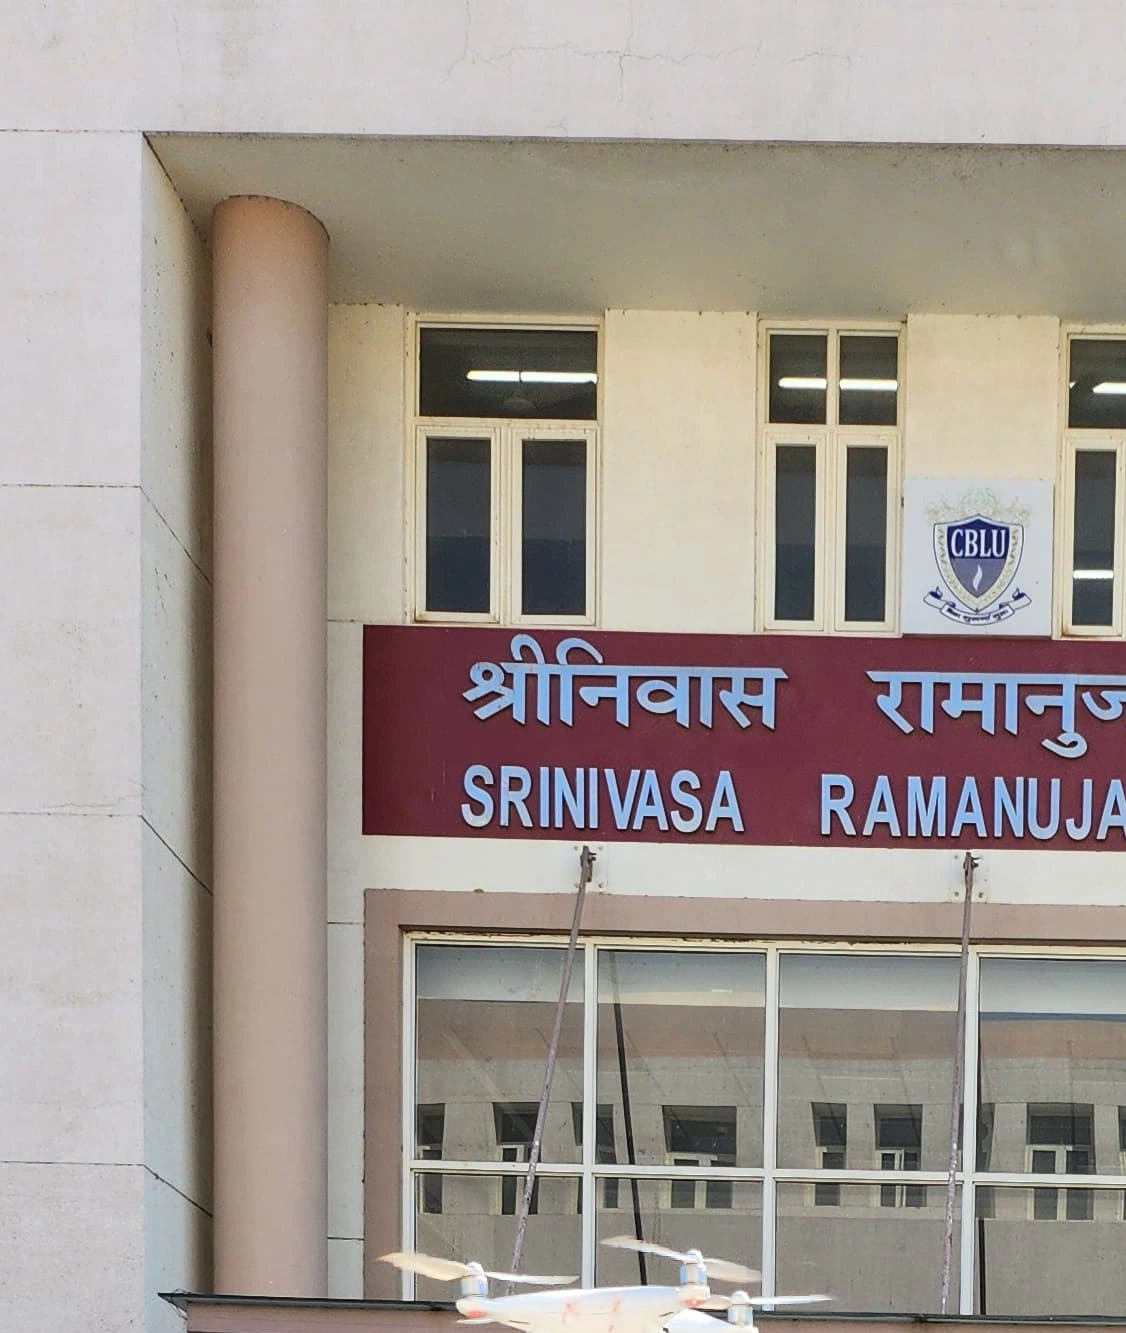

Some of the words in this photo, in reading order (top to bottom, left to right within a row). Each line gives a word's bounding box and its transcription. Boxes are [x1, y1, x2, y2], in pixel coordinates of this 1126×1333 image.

[951, 529, 1006, 558] CBLU
[463, 634, 788, 730] श्रीनिवास
[461, 764, 745, 833] SRINIVASA
